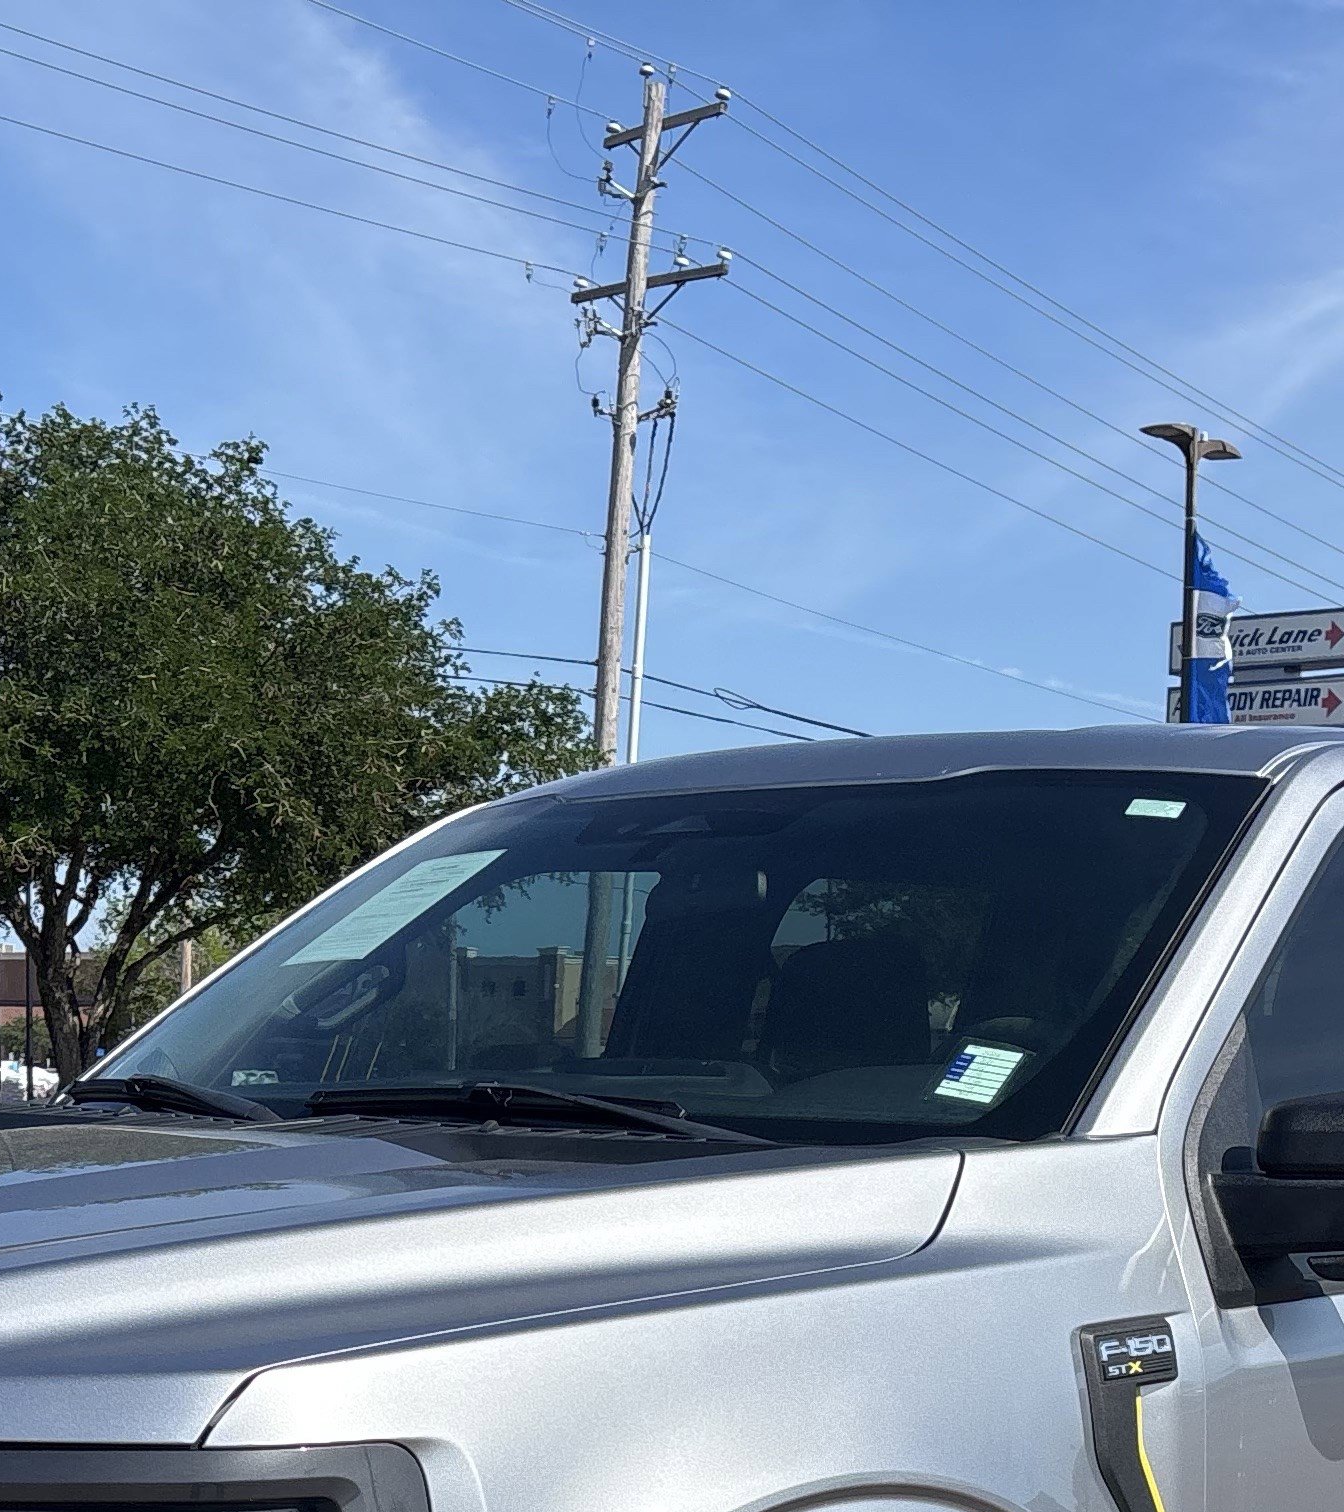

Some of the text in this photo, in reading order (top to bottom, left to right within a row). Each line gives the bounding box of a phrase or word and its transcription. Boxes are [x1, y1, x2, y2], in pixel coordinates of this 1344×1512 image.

[1228, 625, 1323, 649] ick Lane
[1270, 645, 1304, 654] CENTER
[1227, 688, 1321, 711] ODY REPAIR
[1099, 1334, 1172, 1362] F-150
[1107, 1360, 1144, 1377] STX
